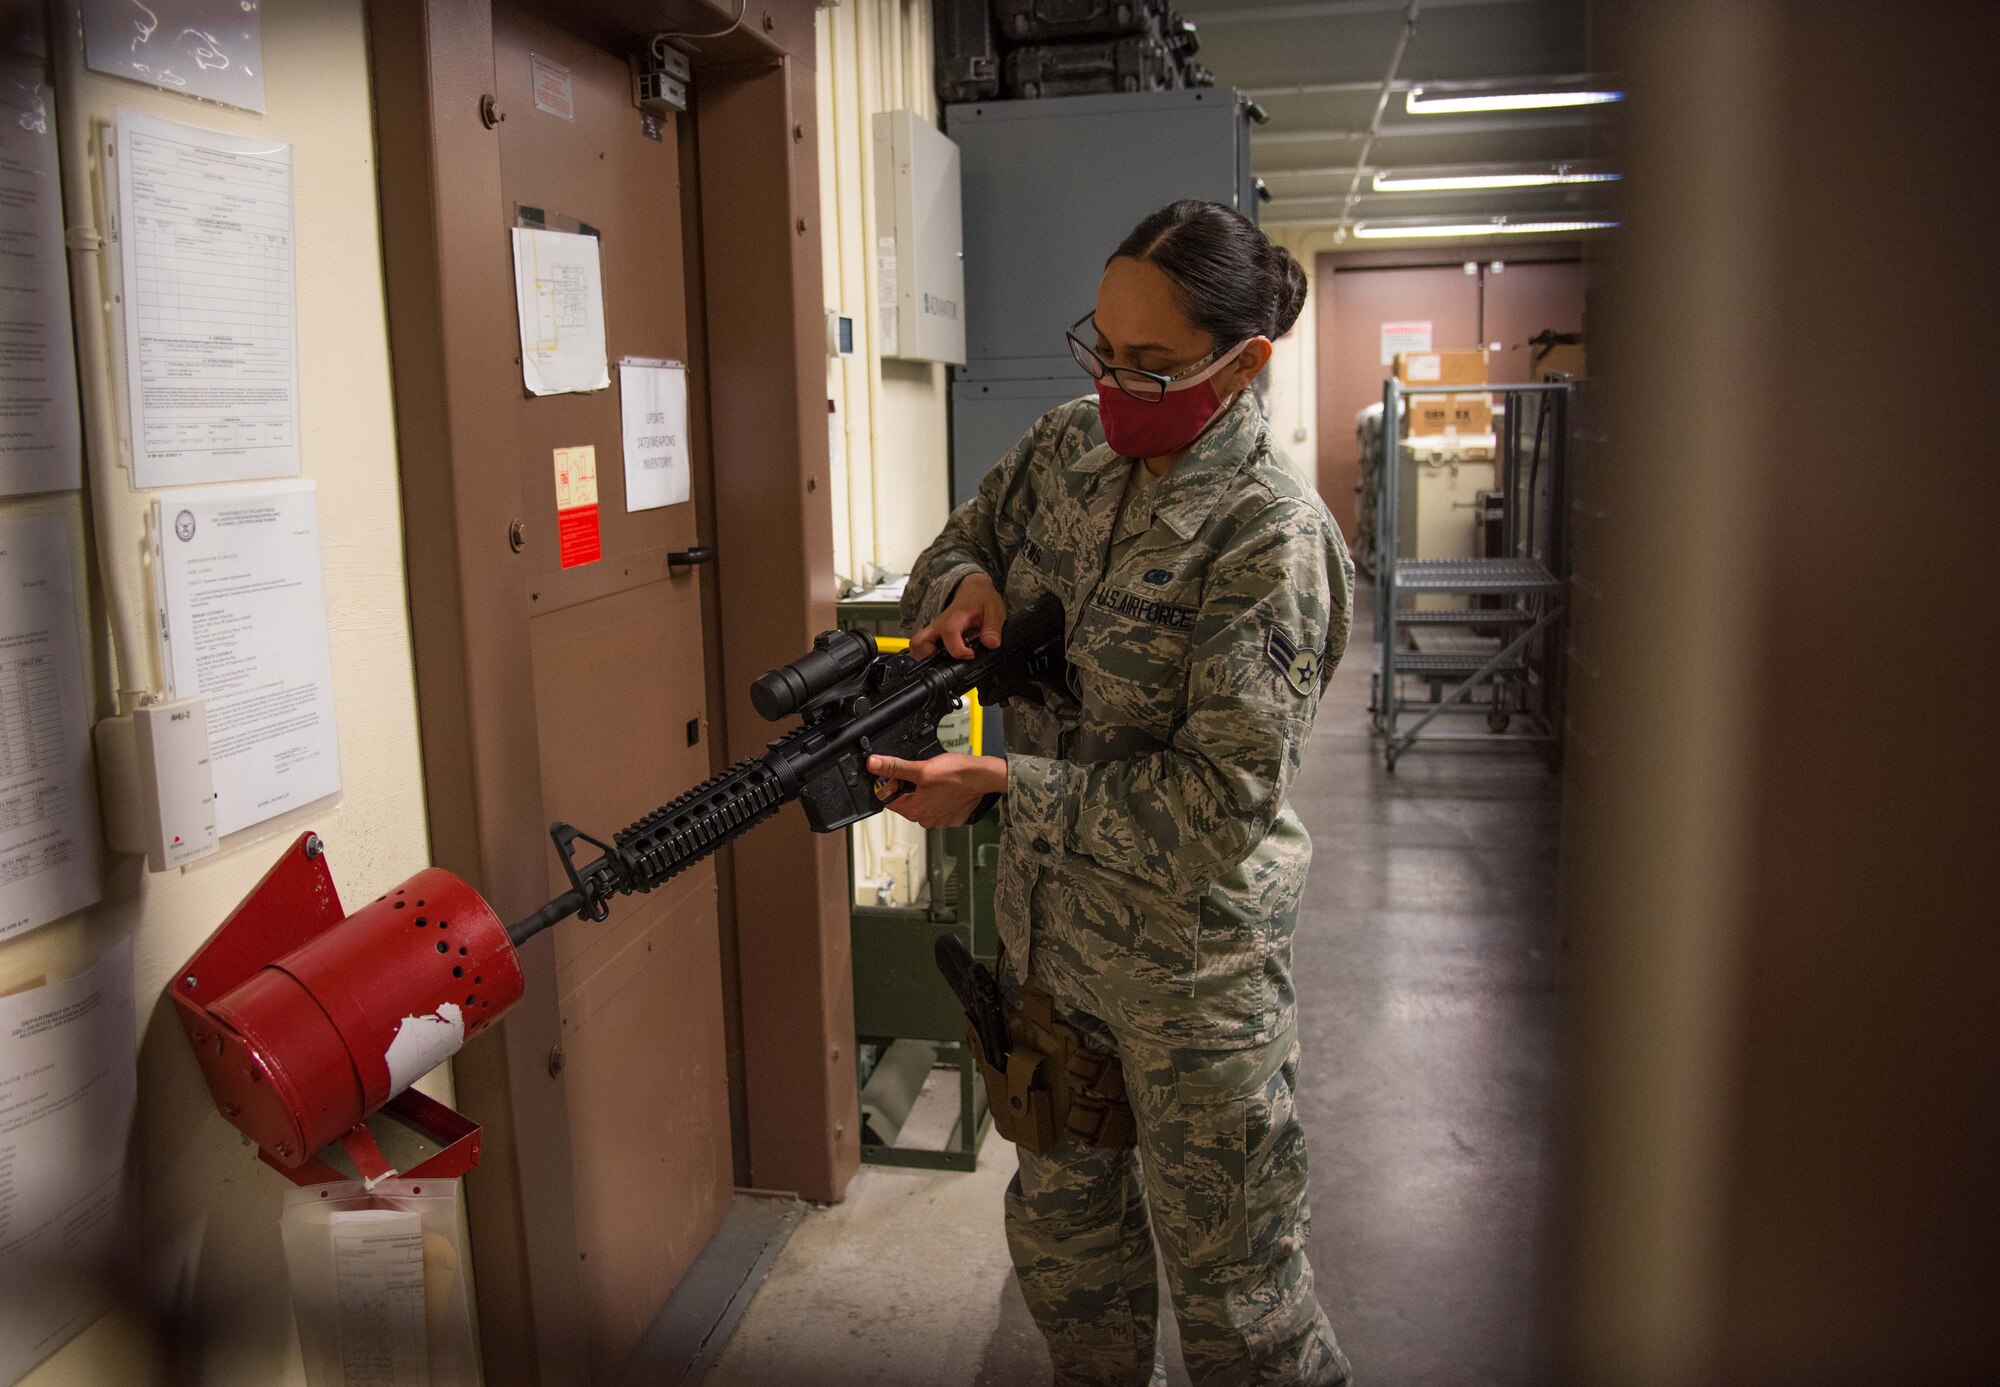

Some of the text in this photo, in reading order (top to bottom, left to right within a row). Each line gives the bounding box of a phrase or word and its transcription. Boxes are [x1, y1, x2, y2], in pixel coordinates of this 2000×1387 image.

[646, 412, 665, 424] UPDATE
[1138, 599, 1193, 629] FORCE
[1027, 655, 1048, 675] 117
[171, 711, 191, 722] AHU-2
[21, 1010, 63, 1027] DEPARTMENT
